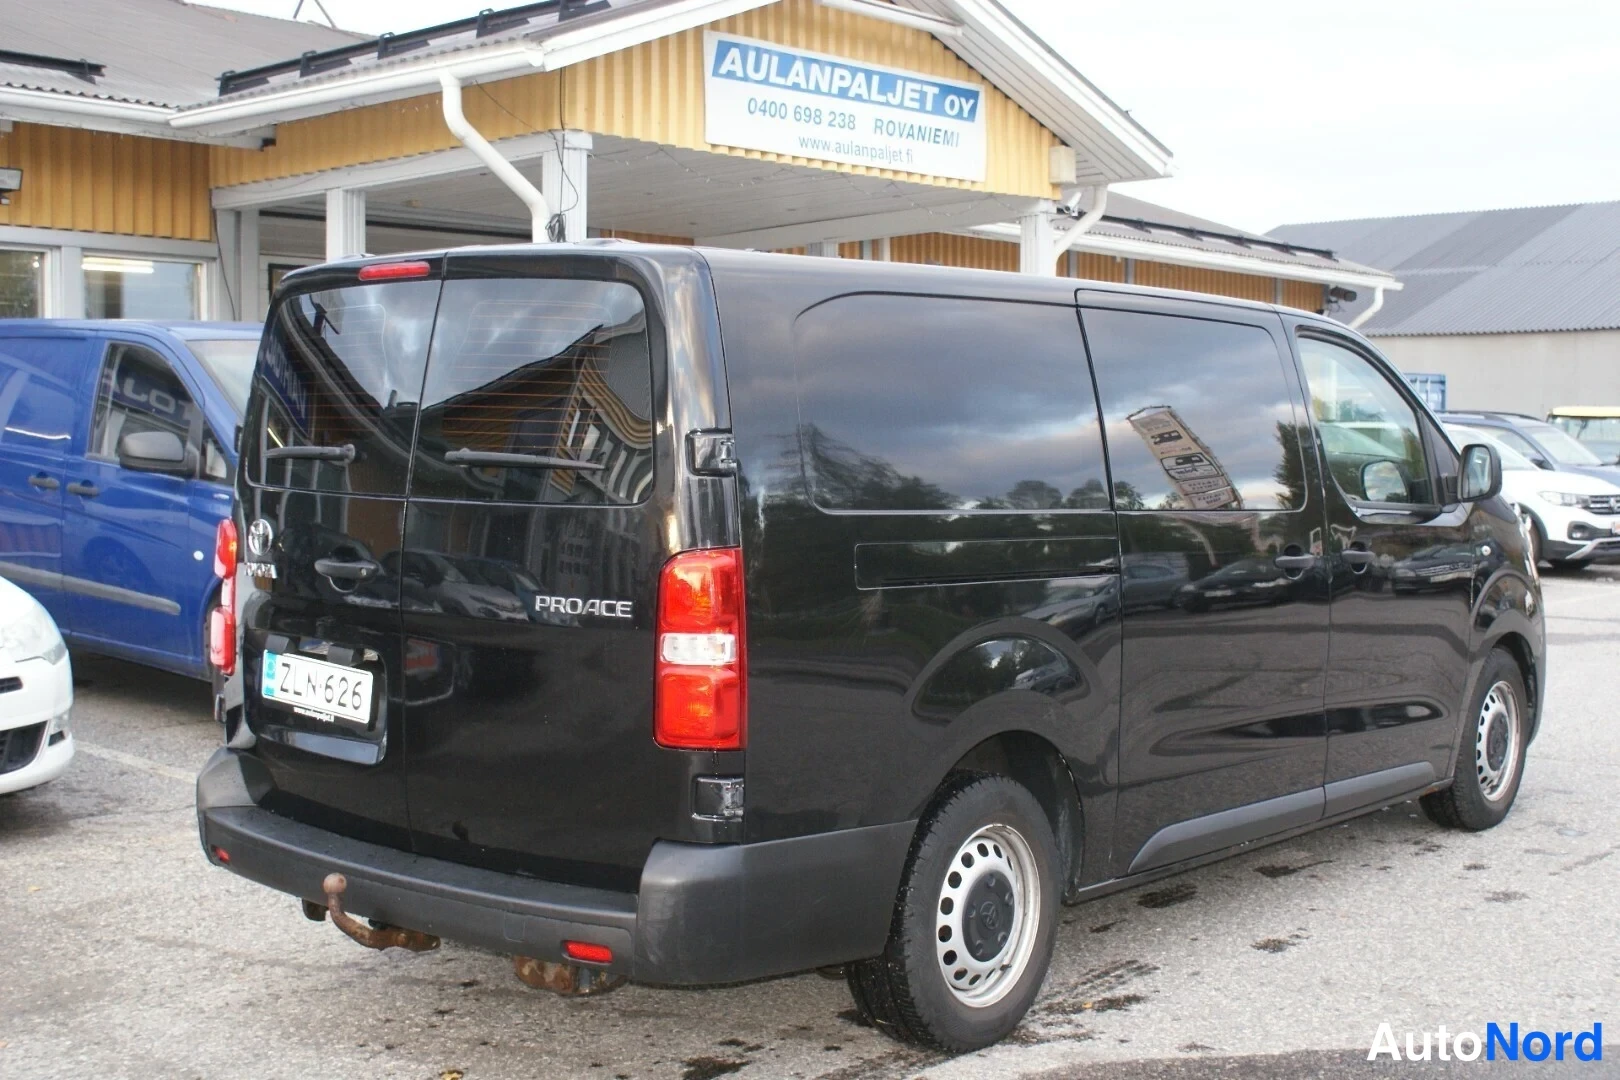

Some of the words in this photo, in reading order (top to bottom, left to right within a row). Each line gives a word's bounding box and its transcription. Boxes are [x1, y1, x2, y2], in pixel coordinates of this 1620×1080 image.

[718, 46, 940, 112] AULANPALJET
[944, 94, 975, 118] OY
[747, 97, 788, 120] 0400
[793, 105, 823, 126] 698
[827, 111, 857, 130] 238
[873, 117, 961, 148] ROVANIEMI
[798, 135, 914, 164] www.aulanpaljetfi
[534, 595, 633, 618] PROACE
